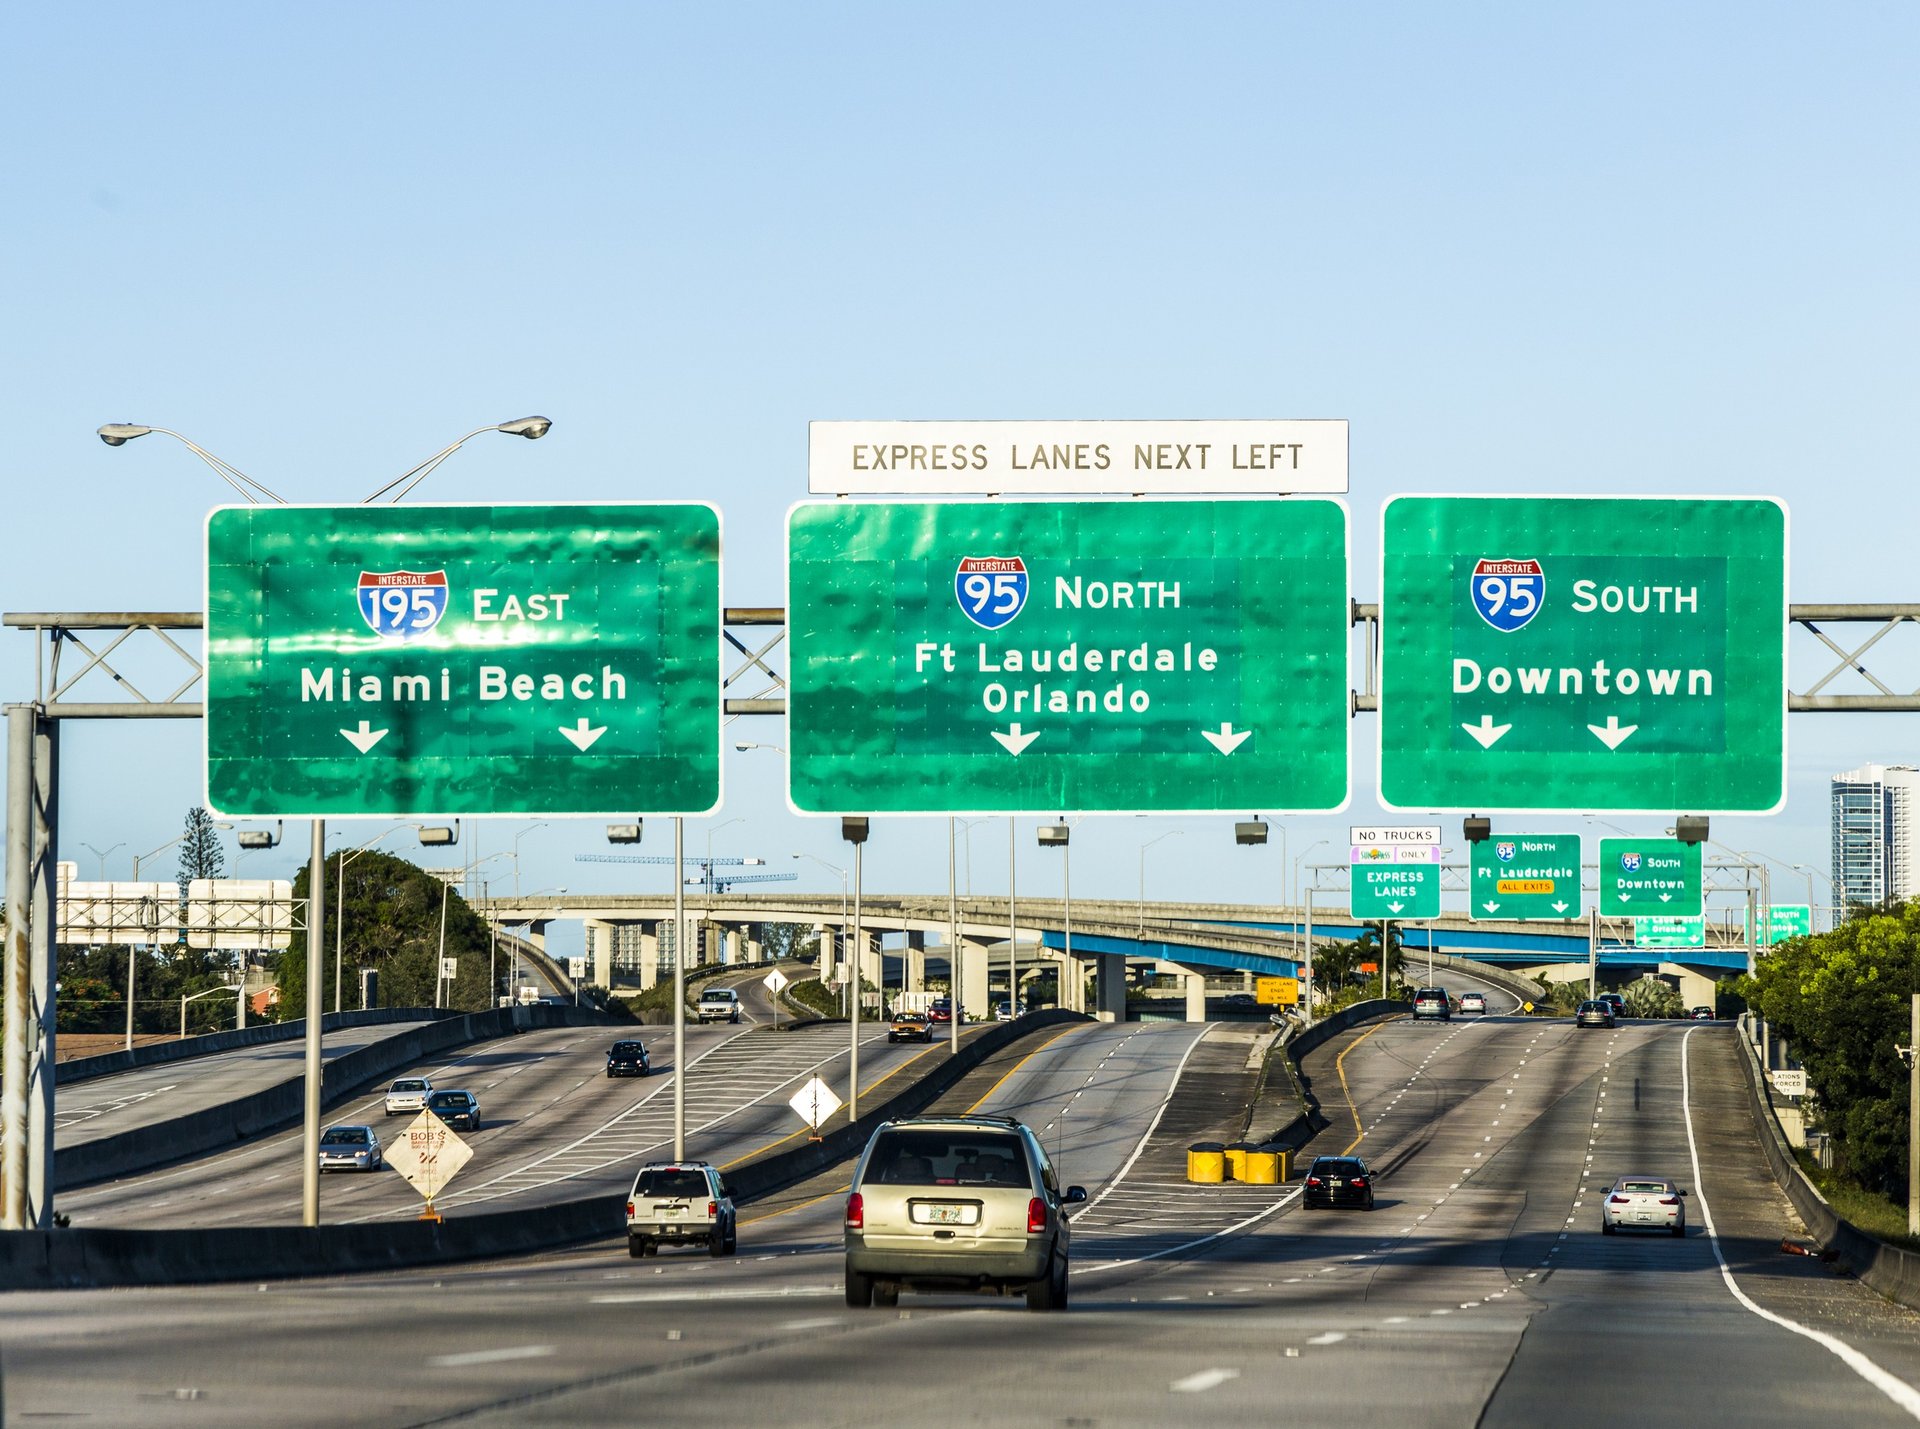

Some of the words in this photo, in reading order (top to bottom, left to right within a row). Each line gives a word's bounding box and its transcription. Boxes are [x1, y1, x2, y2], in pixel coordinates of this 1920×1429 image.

[853, 444, 988, 470] EXPRESS
[1012, 444, 1111, 470] LANES
[1134, 444, 1211, 470] NEXT
[1232, 444, 1303, 470] LEFT
[967, 561, 1016, 571] INTERSTATE
[1483, 564, 1533, 573] INTERSTATE
[378, 575, 427, 585] INTERSTATE
[964, 574, 1020, 615] 95
[1055, 576, 1181, 609] NORTH
[1480, 577, 1536, 617] 95
[1571, 579, 1697, 613] SOUTH
[369, 588, 437, 628] 195
[474, 588, 569, 621] EAST
[915, 642, 956, 673] Ft
[979, 641, 1218, 673] Lauderdale
[301, 667, 450, 702] Miami
[479, 664, 626, 700] Beach
[1452, 658, 1713, 696] Downtown
[983, 682, 1150, 713] Orlando
[1359, 831, 1376, 840] NO
[1384, 831, 1433, 840] TRUCKS
[1521, 841, 1556, 852] NORTH
[1401, 851, 1427, 859] ONLY
[1498, 847, 1514, 859] 95
[1624, 857, 1640, 869] 95
[1647, 857, 1681, 868] SOUTH
[1367, 871, 1424, 883] EXPRESS
[1478, 867, 1492, 879] Ft
[1500, 867, 1573, 878] Lauderdale
[1617, 878, 1685, 889] Downtown
[1375, 886, 1417, 897] LANES
[1652, 925, 1687, 933] Orlando
[411, 1132, 445, 1141] BOB'S
